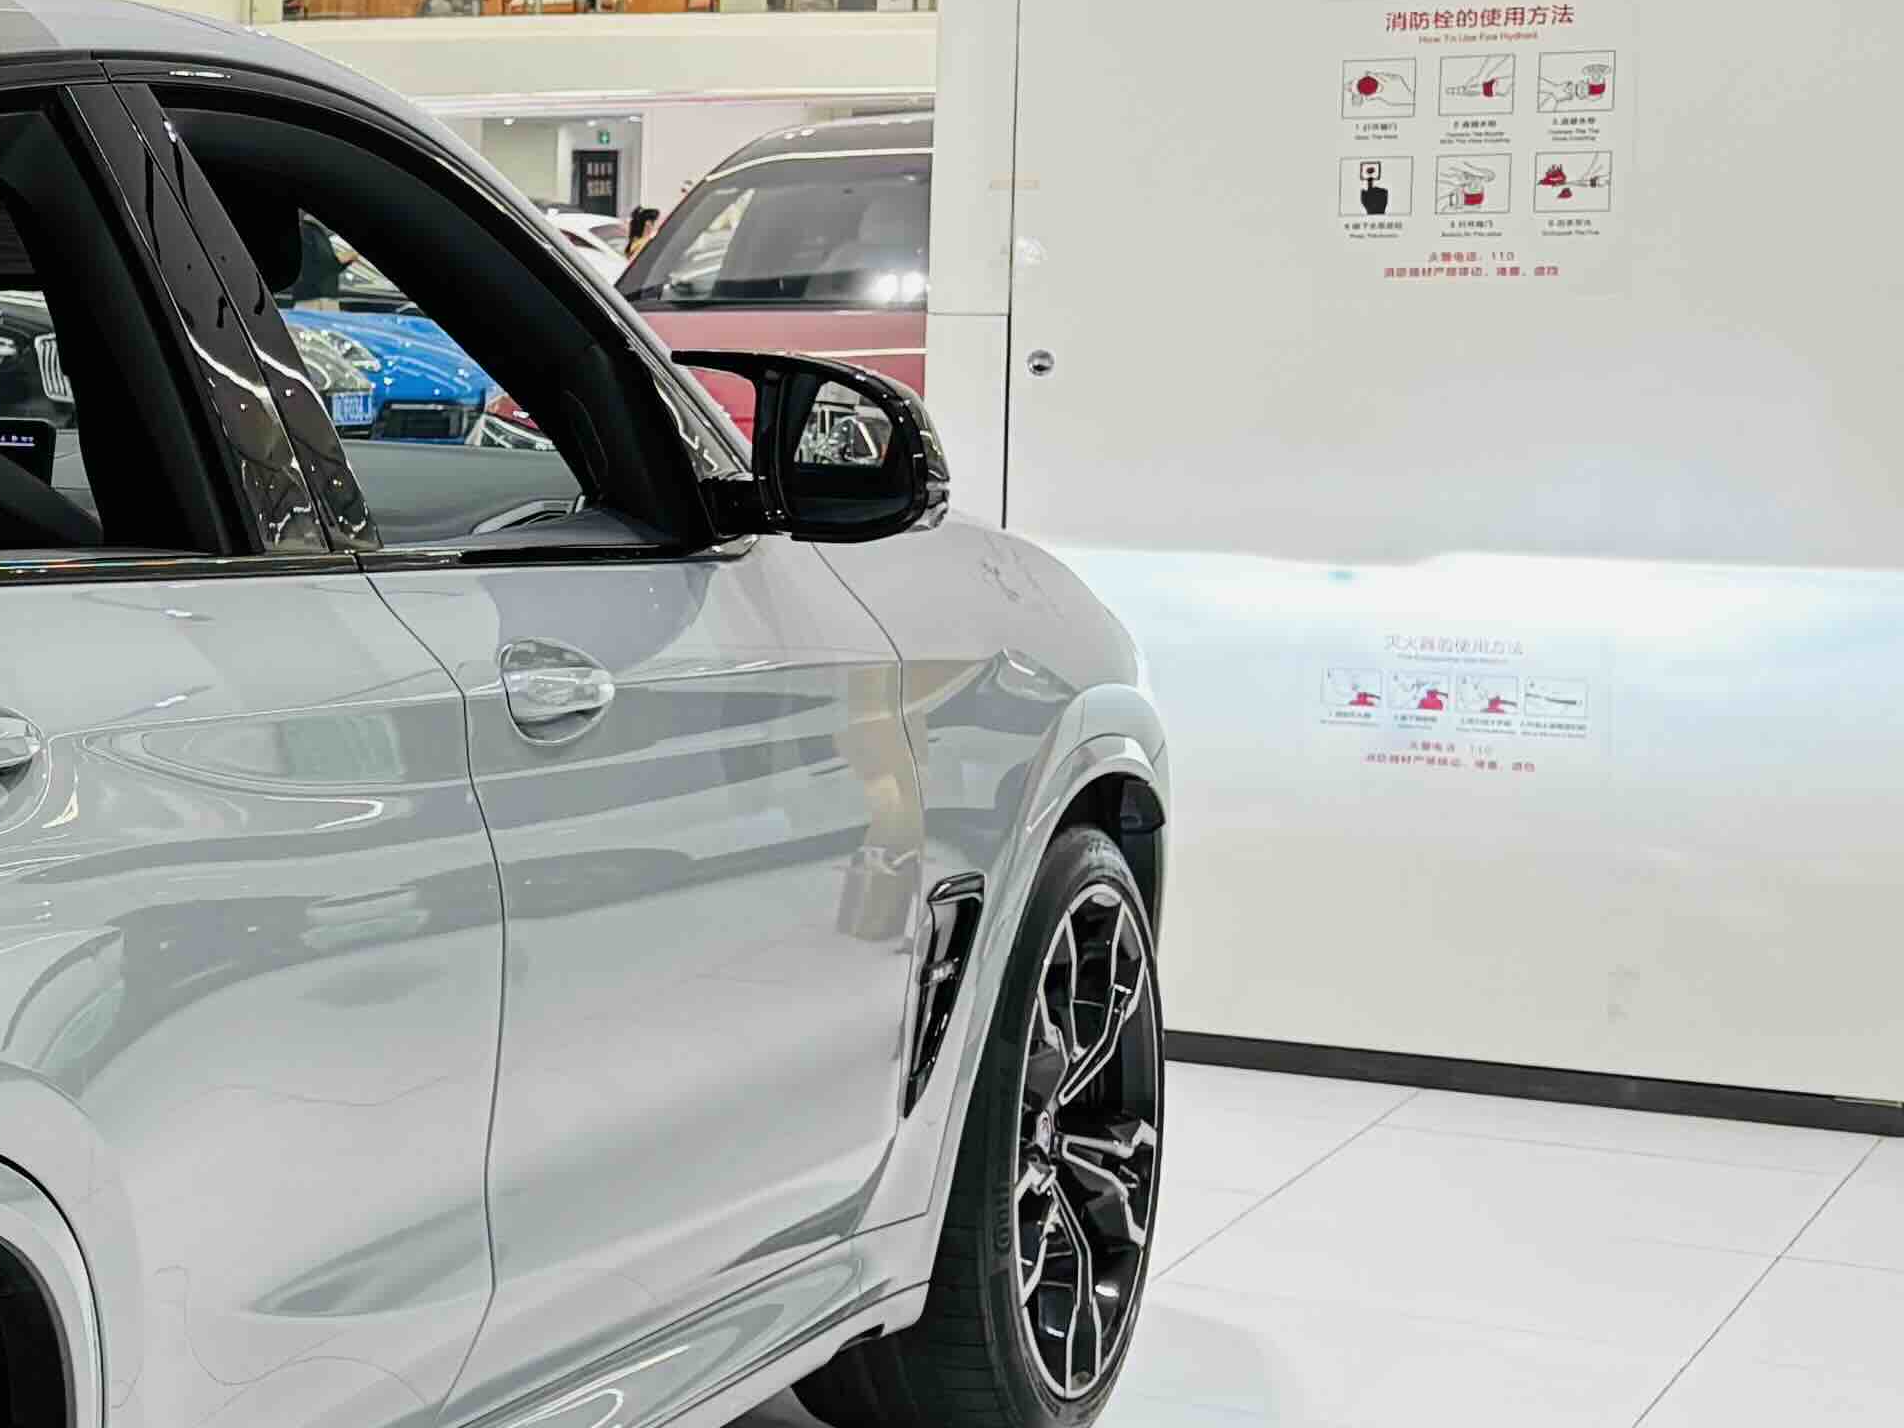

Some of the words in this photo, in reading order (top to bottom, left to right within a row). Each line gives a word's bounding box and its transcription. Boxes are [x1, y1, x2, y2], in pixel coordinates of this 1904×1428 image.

[1385, 3, 1575, 32] 消防栓的使用方法
